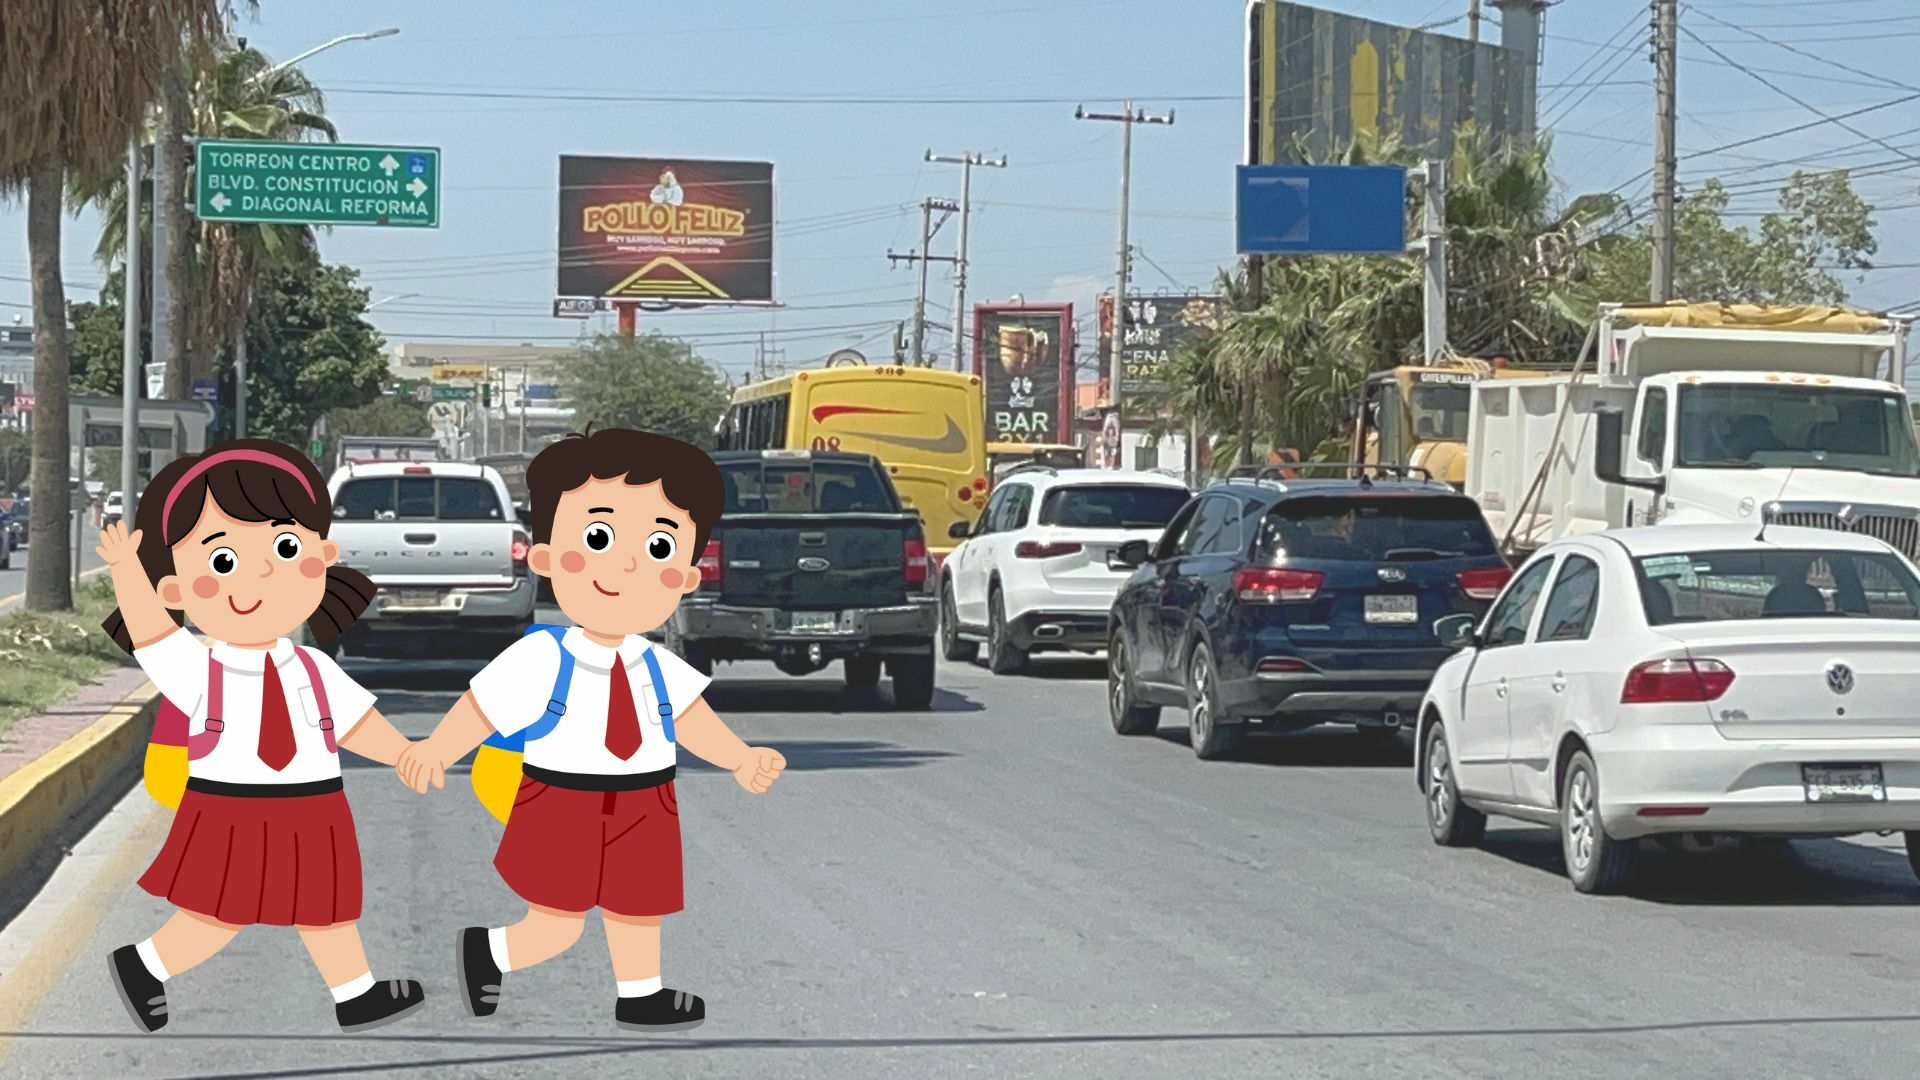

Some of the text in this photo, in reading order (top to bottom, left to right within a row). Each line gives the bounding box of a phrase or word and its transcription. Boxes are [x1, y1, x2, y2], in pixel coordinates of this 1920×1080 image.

[209, 152, 371, 172] TORREON CENTRO
[208, 174, 398, 194] BLVD. CONSTITUCION
[242, 196, 428, 215] DIAGONAL REFORMA
[584, 203, 743, 235] POLLO FELIZ
[995, 411, 1049, 432] BAR
[347, 550, 494, 558] TACOMA
